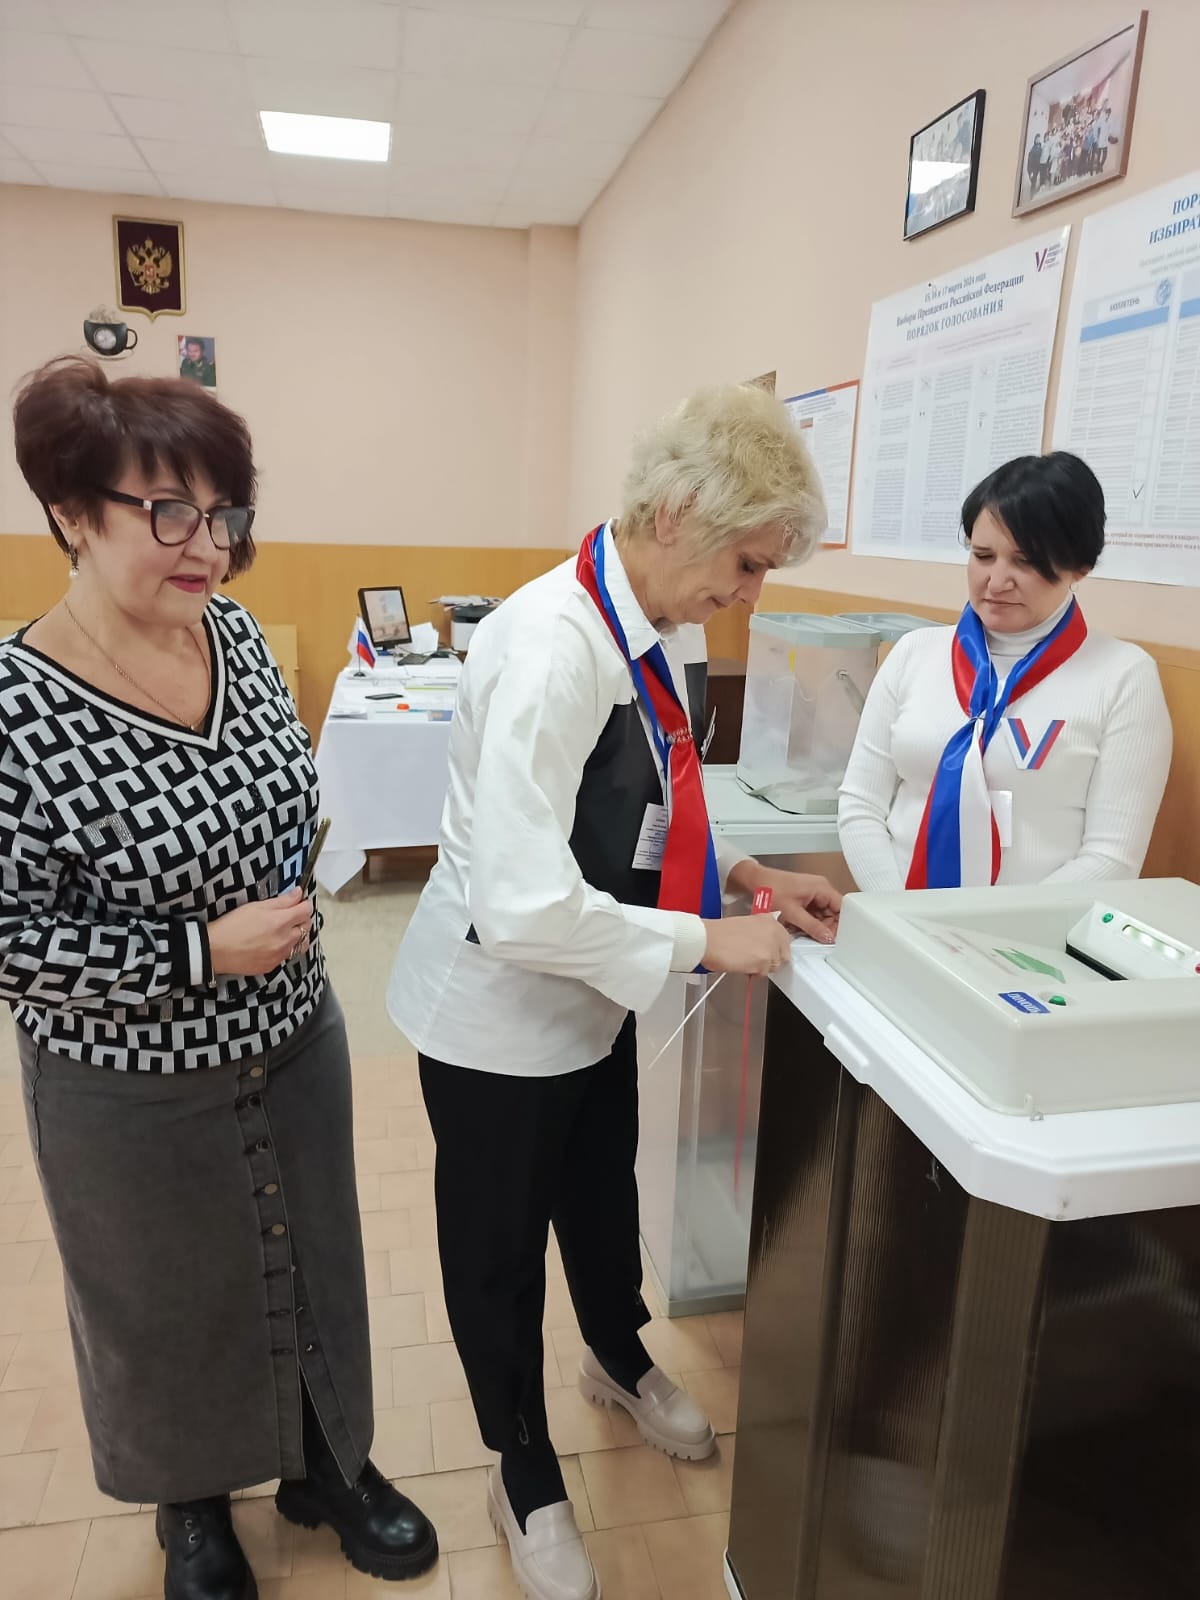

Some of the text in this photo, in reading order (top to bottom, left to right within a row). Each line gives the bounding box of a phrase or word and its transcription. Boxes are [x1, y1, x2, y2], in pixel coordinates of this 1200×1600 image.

[906, 320, 940, 342] ПОРЯДОК
[940, 298, 1004, 331] ГОЛОСОВАНИЯ
[917, 301, 948, 321] Президента
[949, 288, 983, 308] Российской
[983, 274, 1025, 295] Федерации
